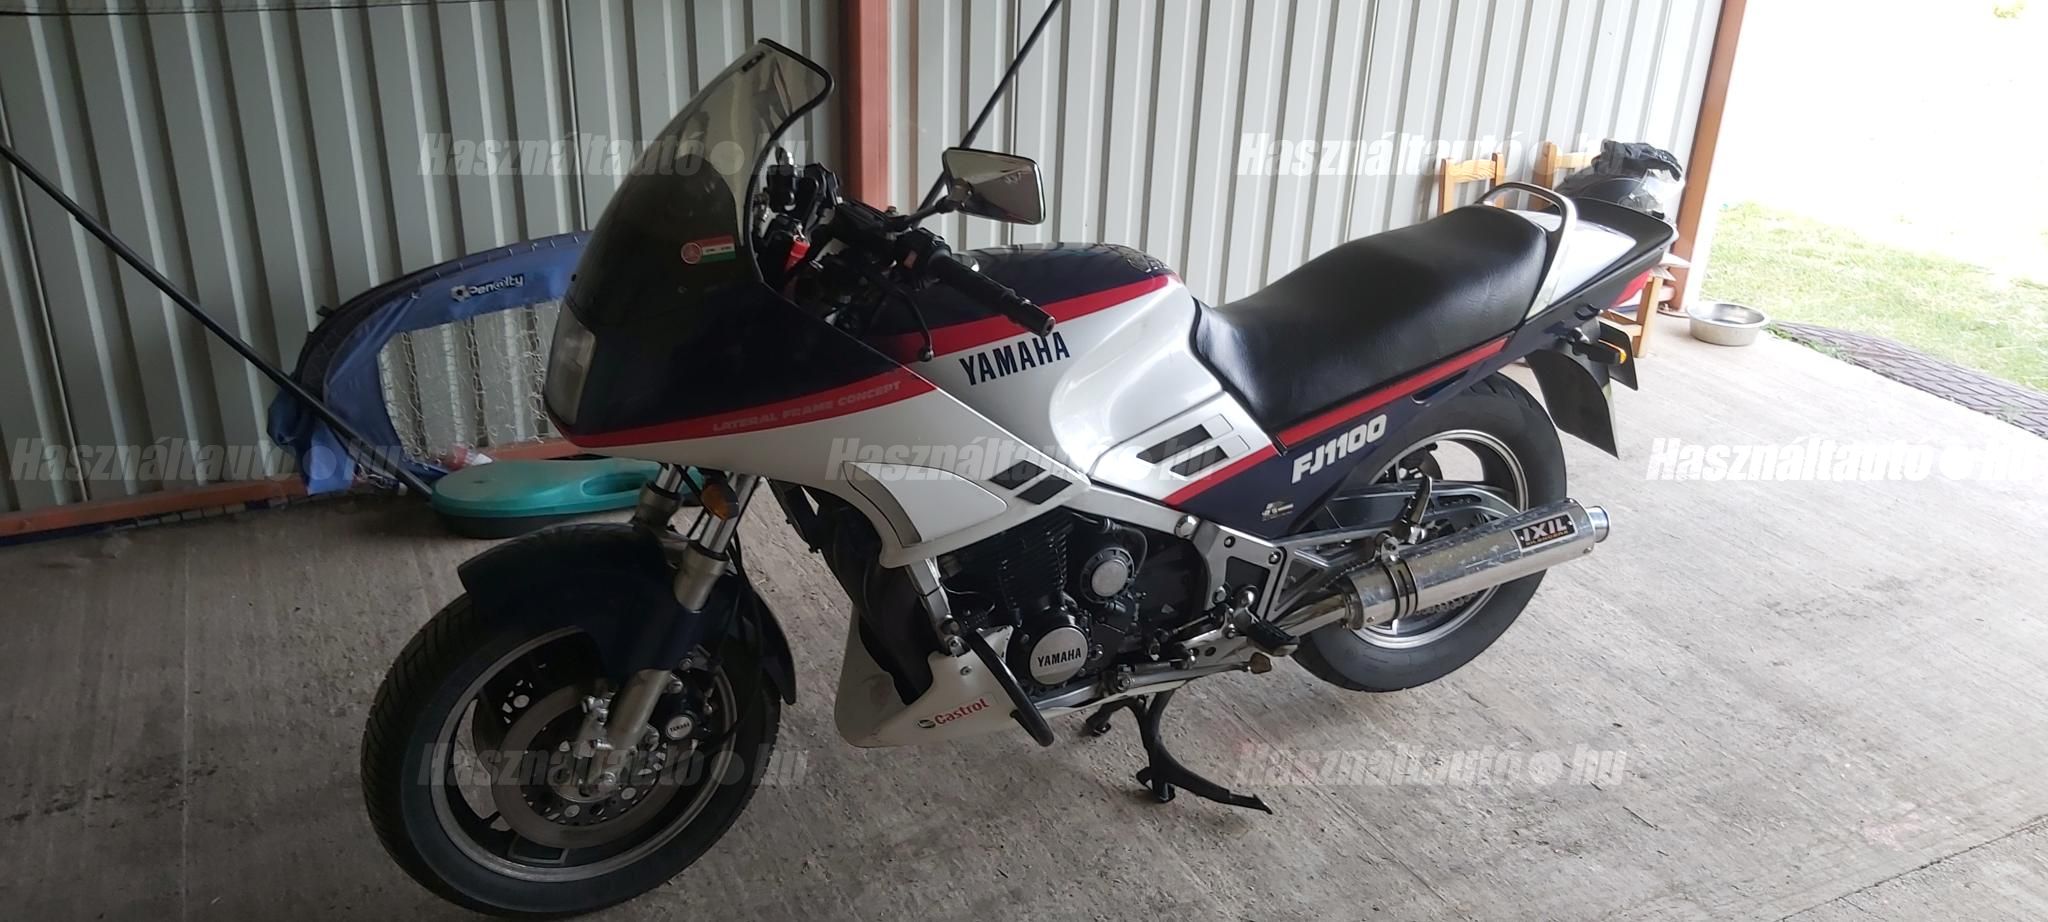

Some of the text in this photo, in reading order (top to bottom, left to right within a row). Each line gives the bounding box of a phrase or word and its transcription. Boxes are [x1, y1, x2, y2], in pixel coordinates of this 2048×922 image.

[959, 331, 1070, 386] YAMAHA
[713, 381, 901, 432] LATERAL FRAME CONCEPT
[1291, 414, 1387, 484] FJ1100
[1523, 518, 1567, 541] IXIL
[1037, 647, 1082, 668] YAMAHA
[934, 698, 990, 726] Castrol
